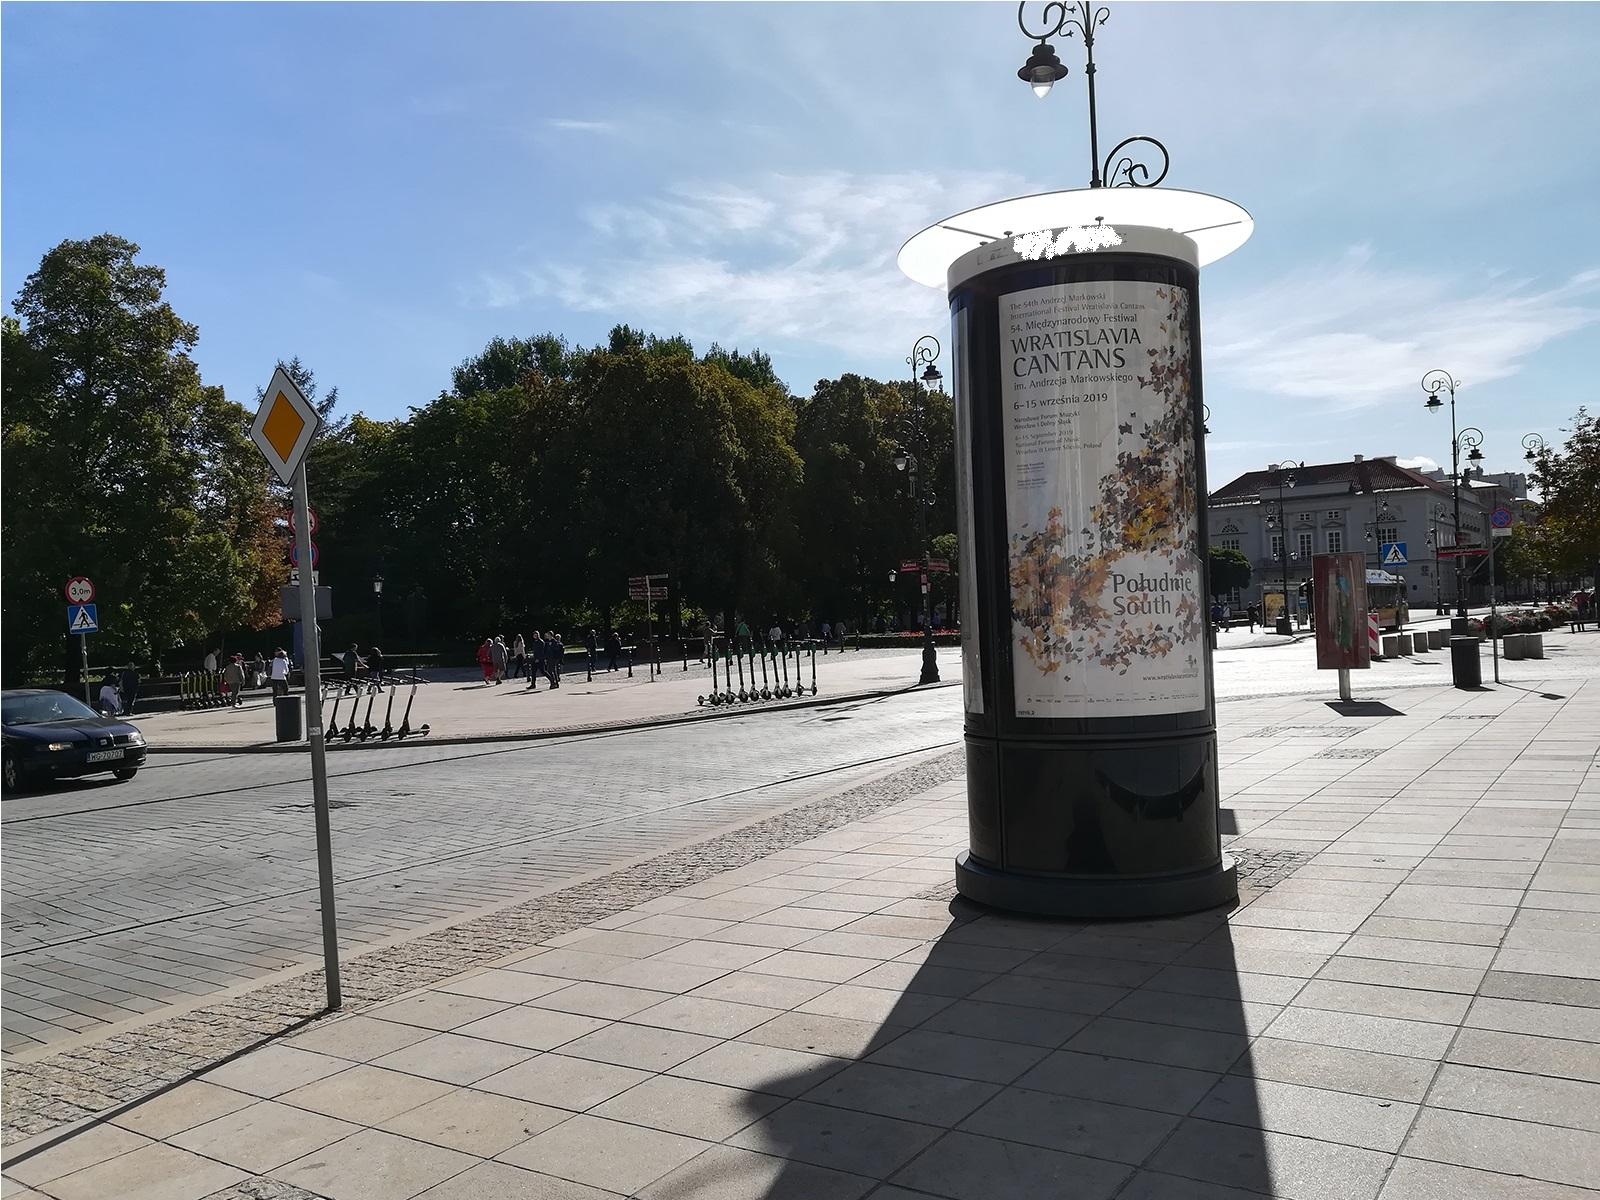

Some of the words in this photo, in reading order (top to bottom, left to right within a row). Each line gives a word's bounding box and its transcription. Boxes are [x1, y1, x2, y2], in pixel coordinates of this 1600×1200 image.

[1010, 303, 1021, 311] The
[1023, 299, 1039, 308] 54th
[1040, 295, 1067, 305] Andrzej
[1069, 292, 1106, 302] Markowski
[1010, 307, 1052, 320] International
[1054, 303, 1080, 313] Festival
[1081, 301, 1119, 311] Wratislavia
[1010, 323, 1024, 333] 54.
[1025, 313, 1101, 331] Międzynarodowy
[1103, 313, 1138, 323] Festiwal
[1010, 327, 1142, 355] WRATISLAVIA
[1013, 347, 1127, 378] CANTANS
[1013, 382, 1028, 391] im.
[1029, 376, 1067, 389] Andrzeja
[1070, 373, 1134, 384] Markowskiego
[1039, 394, 1081, 407] września
[1083, 392, 1109, 403] 2019
[1112, 572, 1192, 593] Południe
[1112, 594, 1171, 616] South
